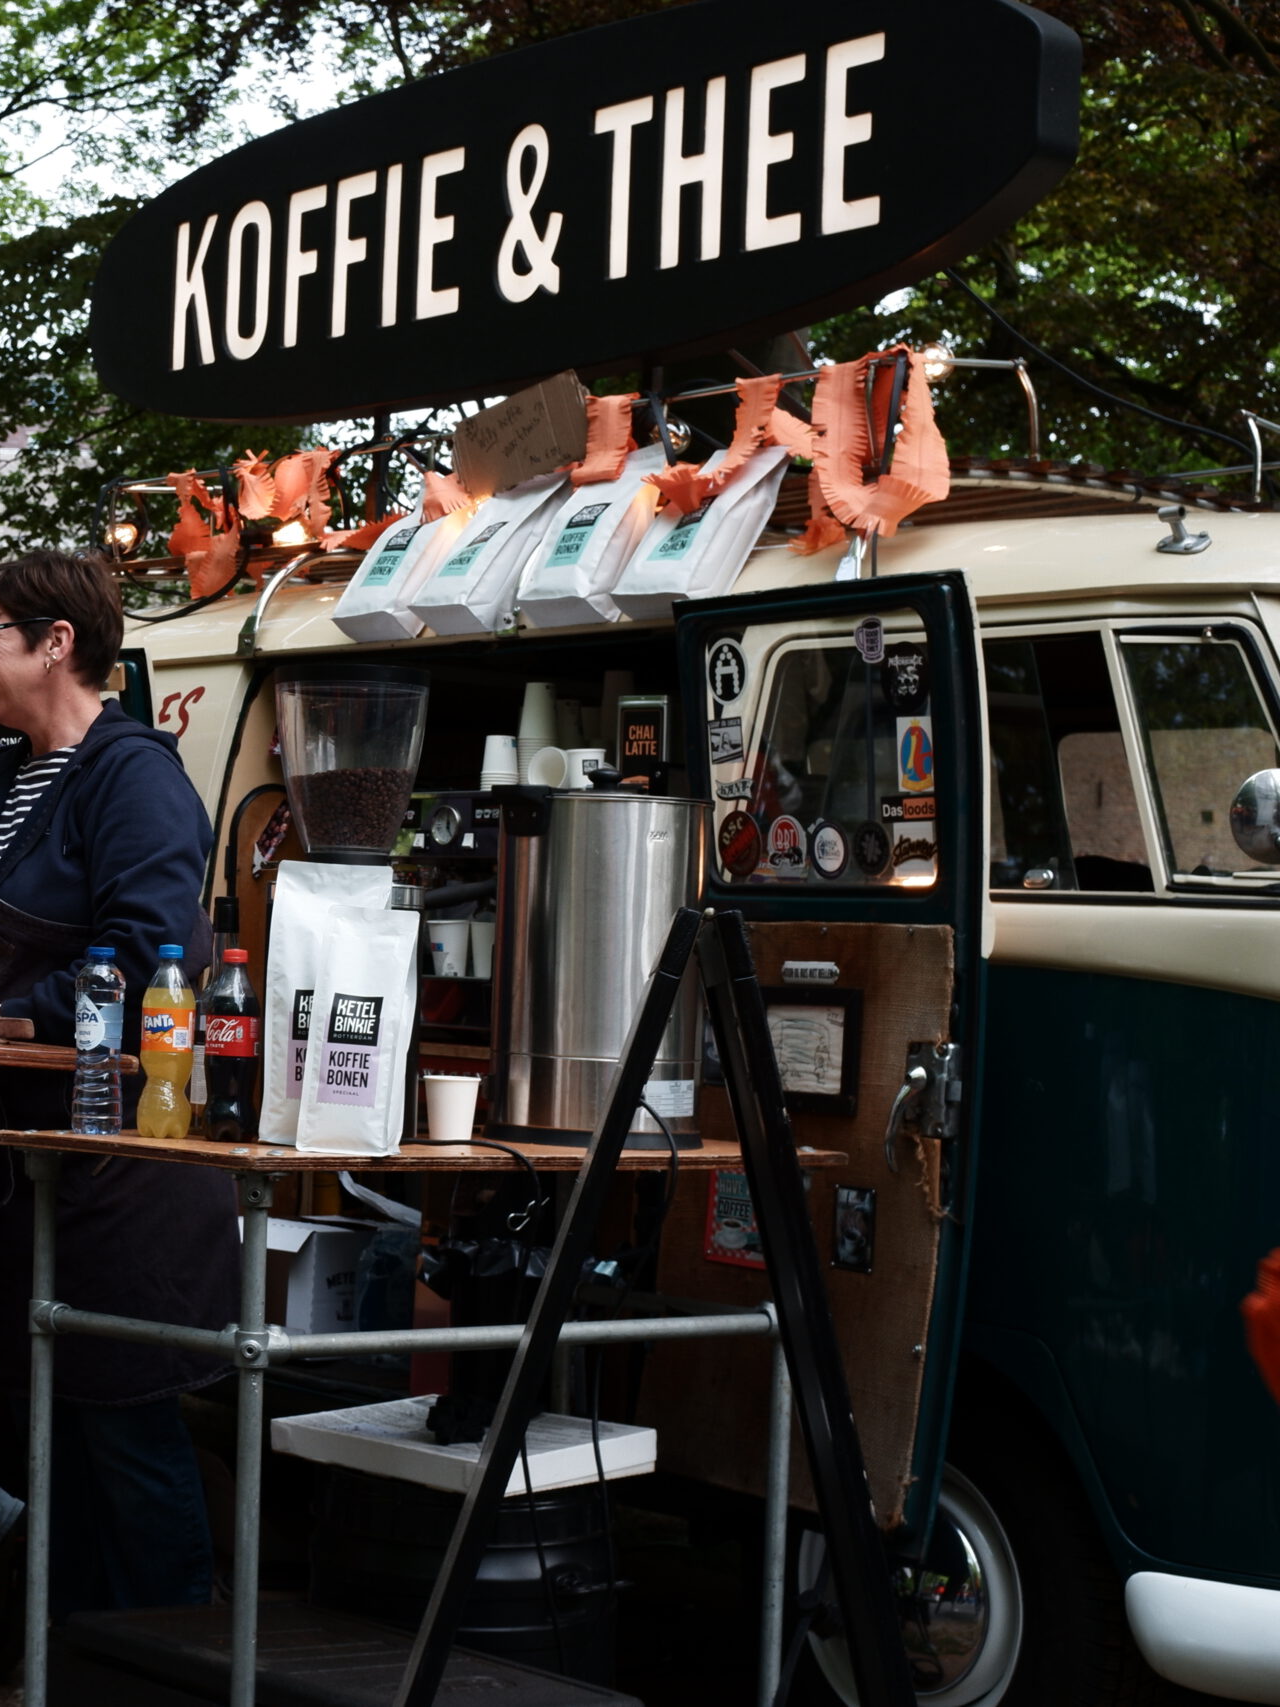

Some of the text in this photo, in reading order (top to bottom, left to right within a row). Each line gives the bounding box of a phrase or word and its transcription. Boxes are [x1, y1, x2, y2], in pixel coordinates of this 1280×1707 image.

[171, 31, 885, 372] KOFFIE & THEE
[628, 725, 655, 740] CHAI
[625, 740, 657, 756] LATTE
[336, 998, 377, 1018] KETEL
[76, 1012, 99, 1023] SPA
[144, 1014, 175, 1029] FANTA
[334, 1016, 376, 1034] BINKIE
[206, 1018, 239, 1042] Cola
[332, 1033, 373, 1041] ROTTERDAM
[328, 1050, 371, 1069] KOFFIE
[326, 1069, 369, 1088] BONEN
[718, 1199, 751, 1219] COFFEE
